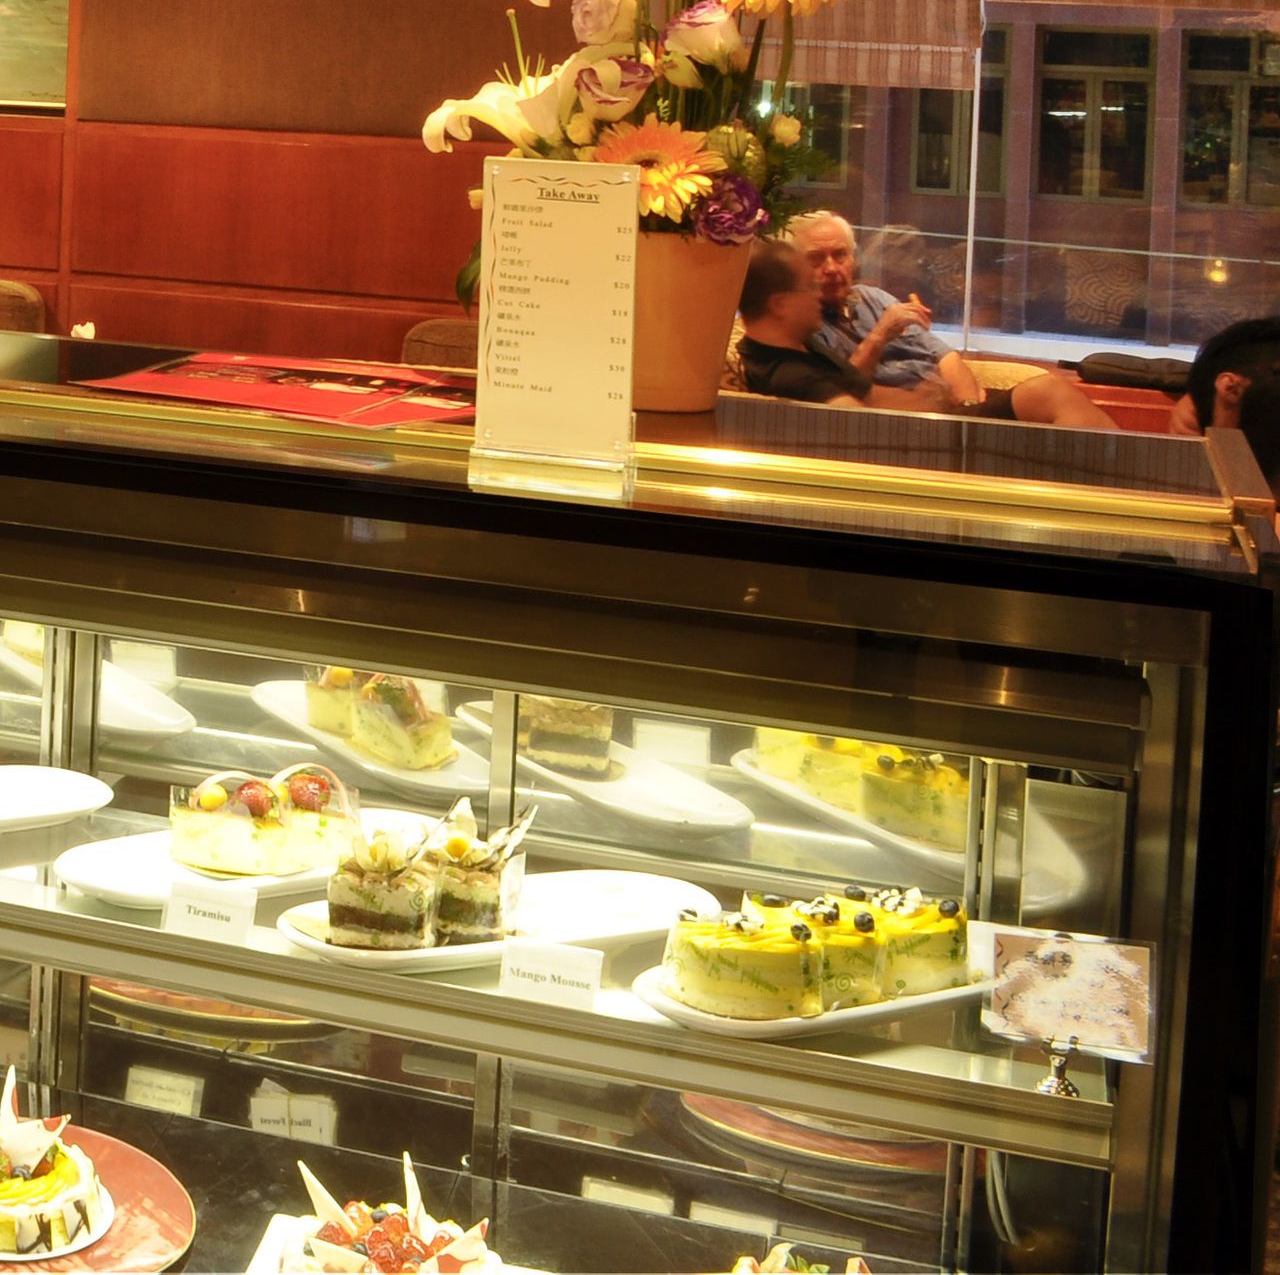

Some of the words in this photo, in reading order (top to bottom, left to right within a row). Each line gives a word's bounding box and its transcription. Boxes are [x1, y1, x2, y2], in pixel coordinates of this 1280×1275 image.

[538, 187, 566, 199] Take
[568, 190, 600, 201] Away
[502, 218, 523, 226] Fruit
[529, 220, 553, 228] Salad
[499, 272, 528, 281] Mango
[534, 275, 570, 285] Pudding
[518, 301, 541, 309] Cake
[530, 384, 553, 393] Maid
[186, 904, 231, 923] Tiramisu
[510, 967, 547, 983] Mango
[551, 974, 591, 989] Mousse
